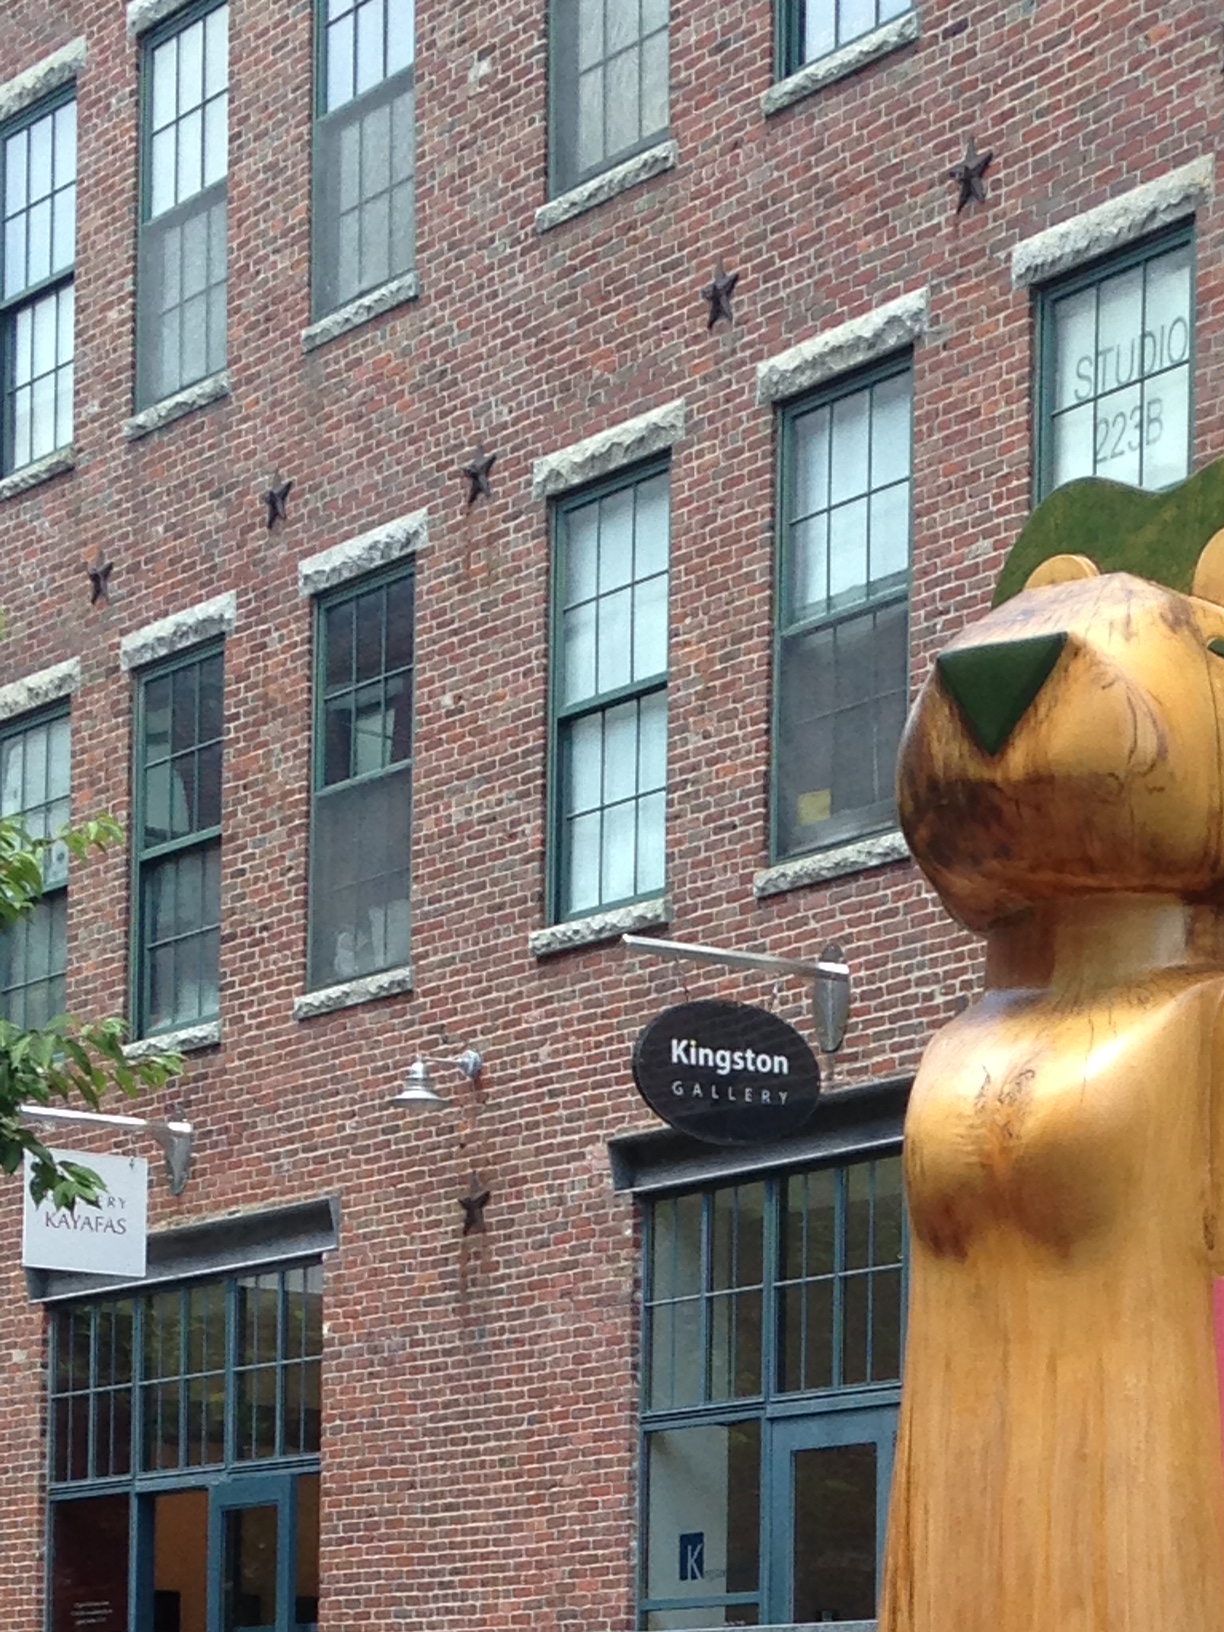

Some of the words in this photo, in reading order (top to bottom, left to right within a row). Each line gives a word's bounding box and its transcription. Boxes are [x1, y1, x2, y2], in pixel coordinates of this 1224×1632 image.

[1074, 316, 1189, 402] STUDIO
[1096, 397, 1163, 463] 223B
[671, 1038, 789, 1075] Kingston
[671, 1080, 788, 1106] GALLERY
[45, 1211, 127, 1235] KAYAFAS
[687, 1543, 703, 1580] K
